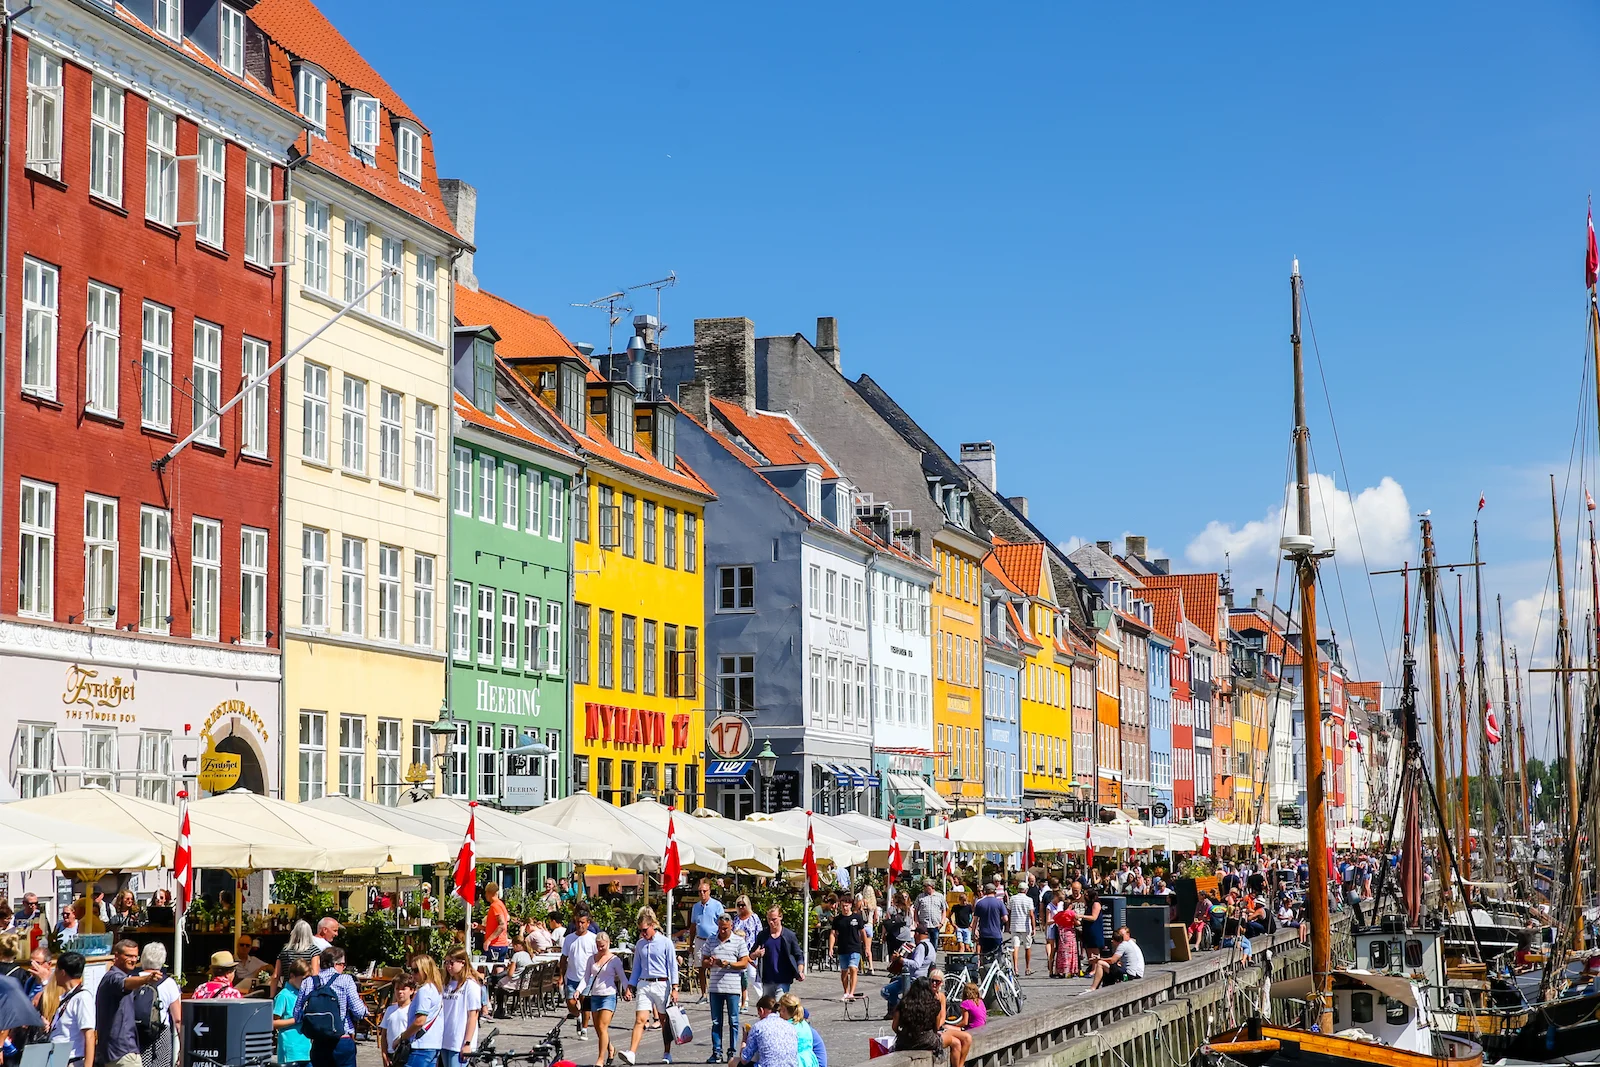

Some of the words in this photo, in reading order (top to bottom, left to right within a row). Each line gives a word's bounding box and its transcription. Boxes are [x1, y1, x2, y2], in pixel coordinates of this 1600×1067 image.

[476, 679, 541, 717] HEERING
[65, 710, 82, 720] THE
[85, 710, 116, 722] TINDER
[120, 713, 136, 723] BOX
[584, 702, 666, 747] NYHAVN
[671, 714, 690, 749] 17
[711, 722, 742, 754] 17
[1195, 807, 1205, 817] 37
